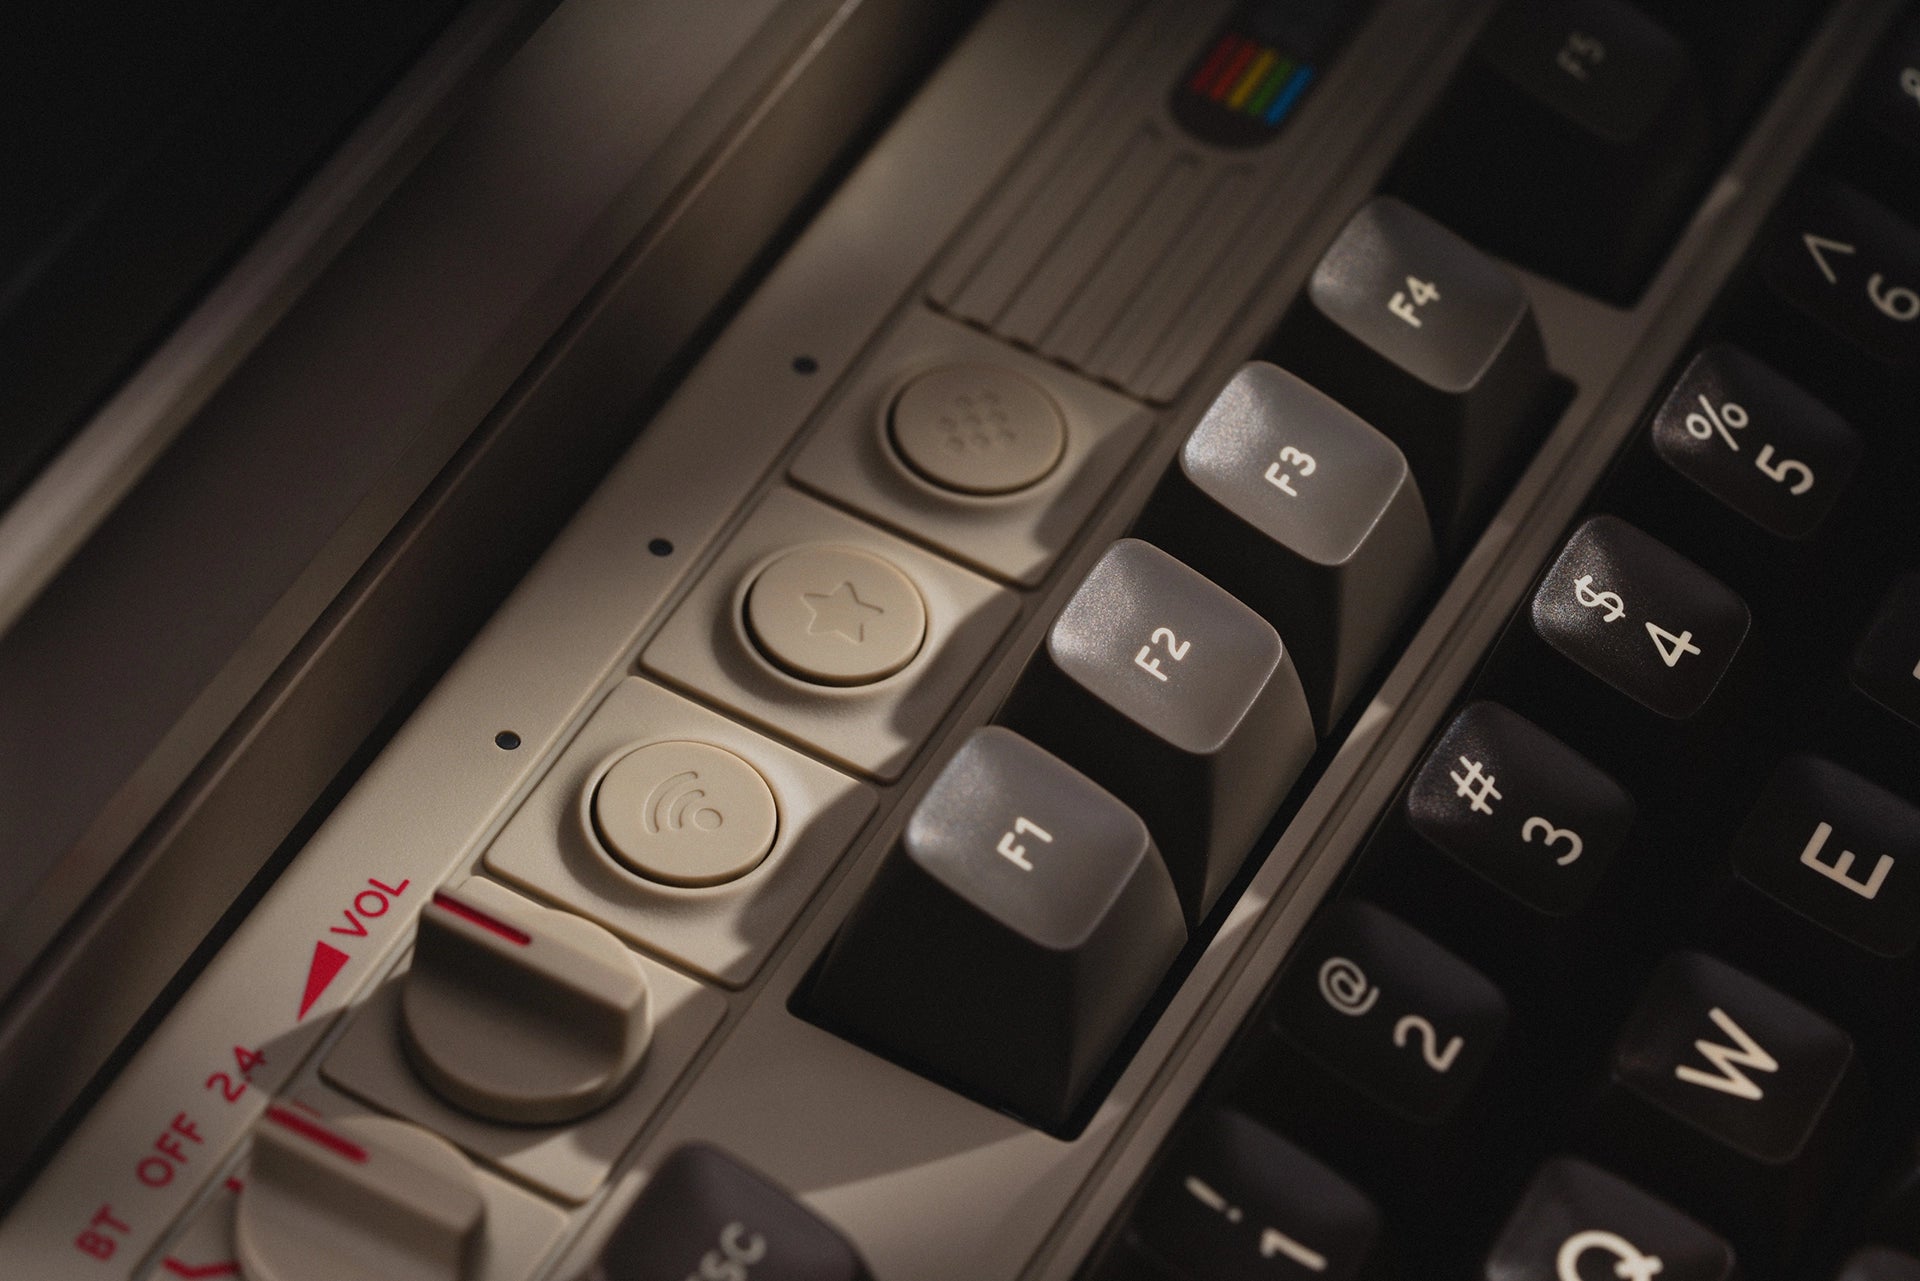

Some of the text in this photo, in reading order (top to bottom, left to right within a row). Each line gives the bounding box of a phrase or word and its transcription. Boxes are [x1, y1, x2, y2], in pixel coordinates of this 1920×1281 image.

[1388, 275, 1441, 328] F4
[1866, 271, 1920, 321] 6
[1685, 393, 1750, 452] %
[1264, 446, 1317, 497] F3
[1755, 443, 1815, 496] 5
[1574, 575, 1626, 623] $
[1134, 627, 1191, 682] F2
[1645, 621, 1701, 668] 4
[1450, 755, 1503, 815] #
[996, 816, 1053, 871] F1
[1521, 816, 1584, 867] 3
[1800, 821, 1895, 900] E
[330, 878, 410, 936] VOL
[1317, 956, 1380, 1017] @
[1393, 1014, 1465, 1073] 2
[1675, 1006, 1779, 1101] W
[75, 1046, 267, 1262] BT OFF 2.4
[684, 1221, 767, 1281] SC
[1260, 1225, 1328, 1272] 1
